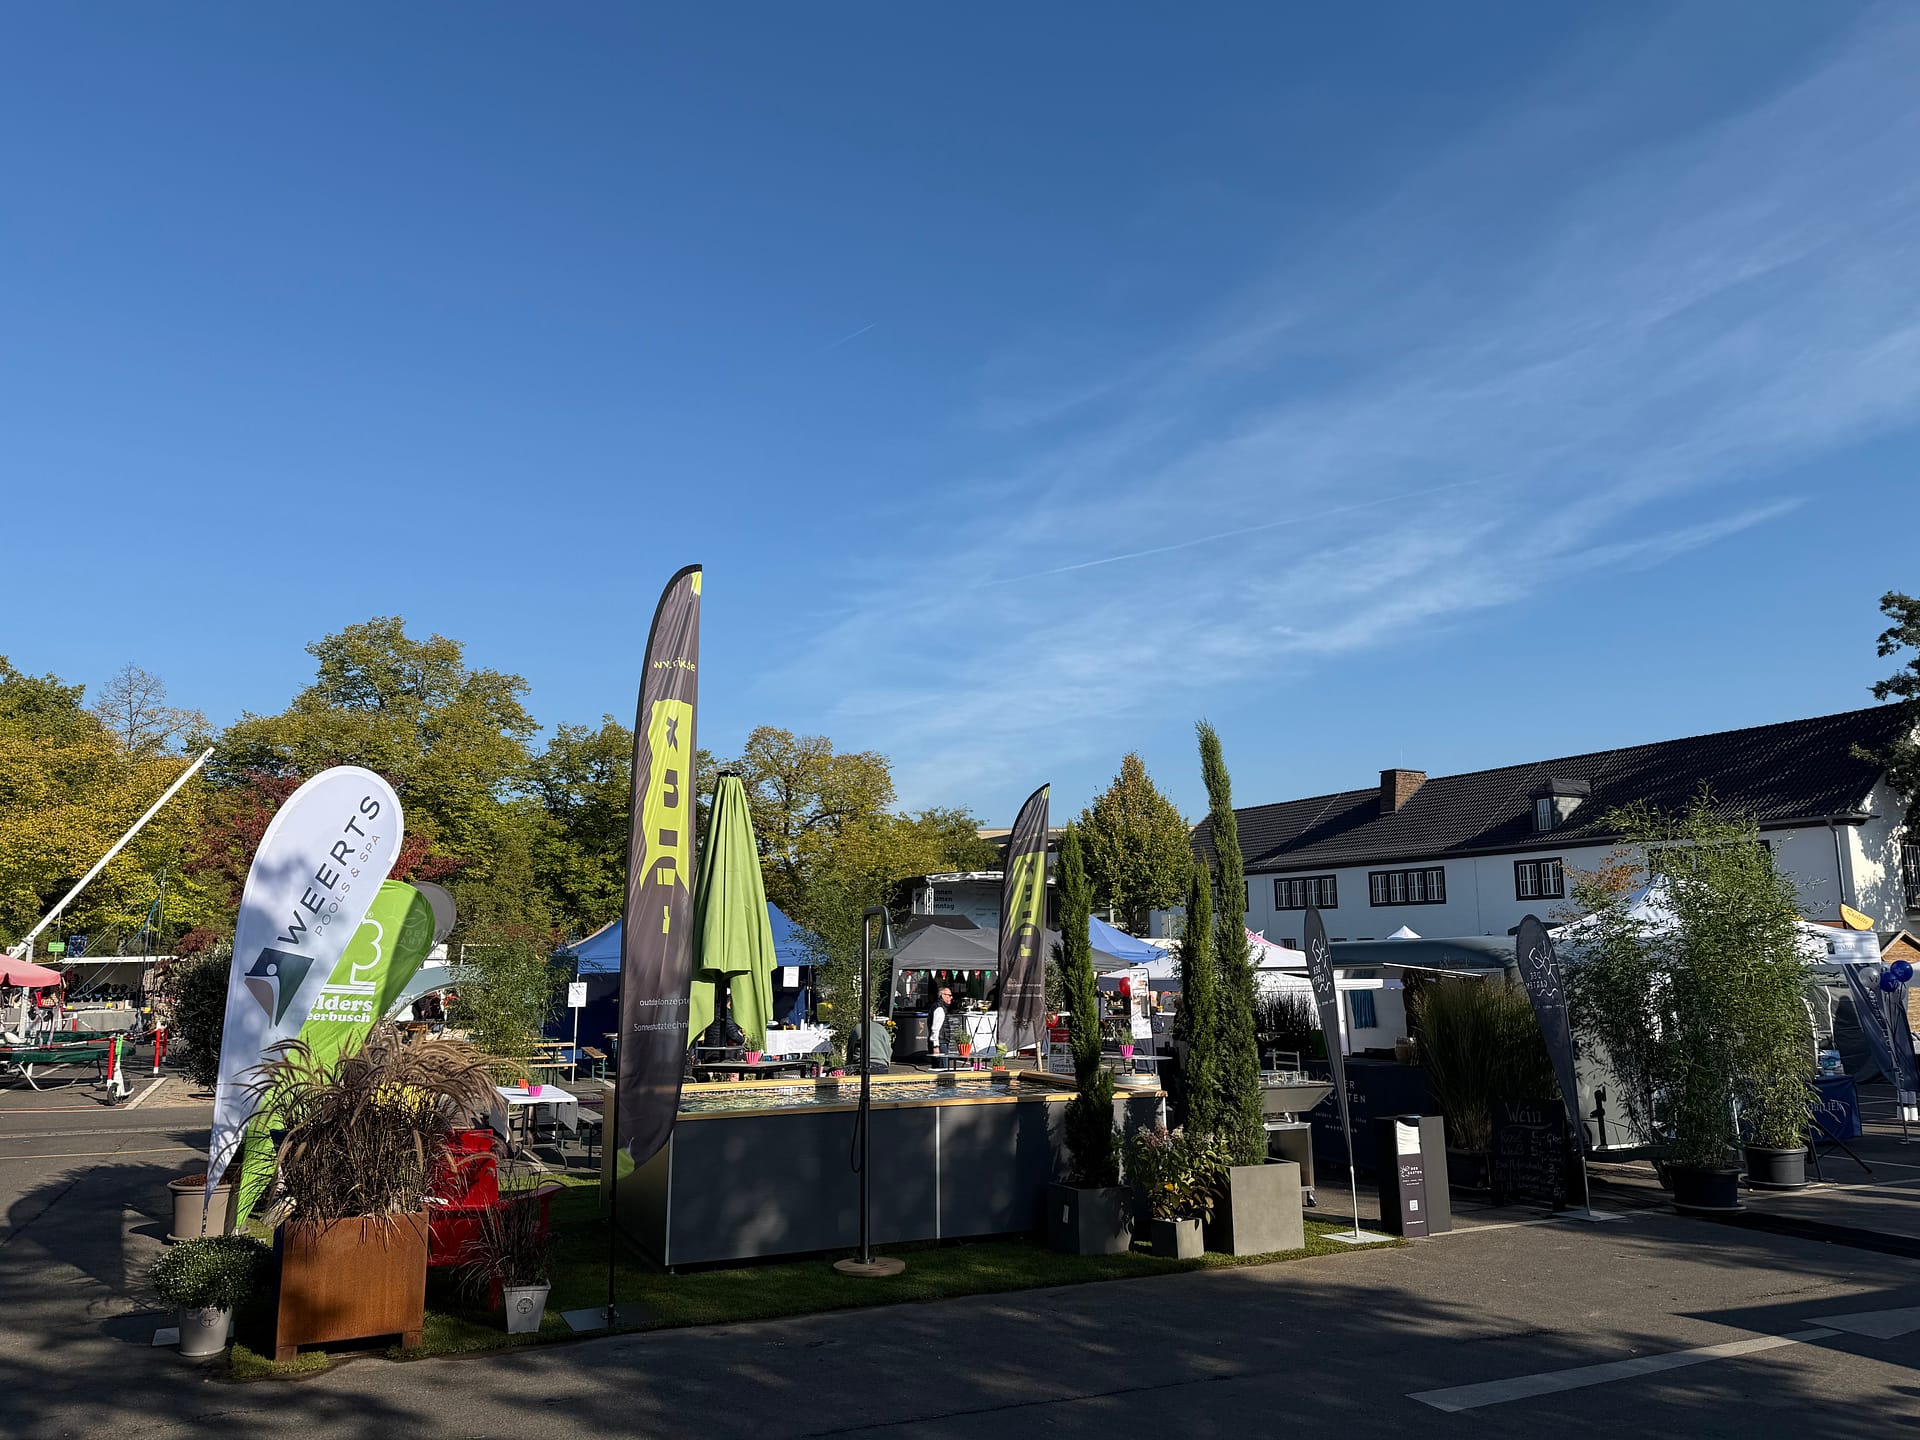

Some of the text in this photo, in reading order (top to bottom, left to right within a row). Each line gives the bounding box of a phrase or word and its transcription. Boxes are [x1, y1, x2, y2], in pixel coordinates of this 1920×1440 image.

[278, 795, 381, 946] WEERTS
[314, 834, 381, 937] POOLS & SPA
[313, 994, 373, 1011] lders
[306, 1011, 370, 1022] eerbusch
[1504, 1100, 1542, 1123] Wein
[1807, 1101, 1843, 1112] OBILIEN
